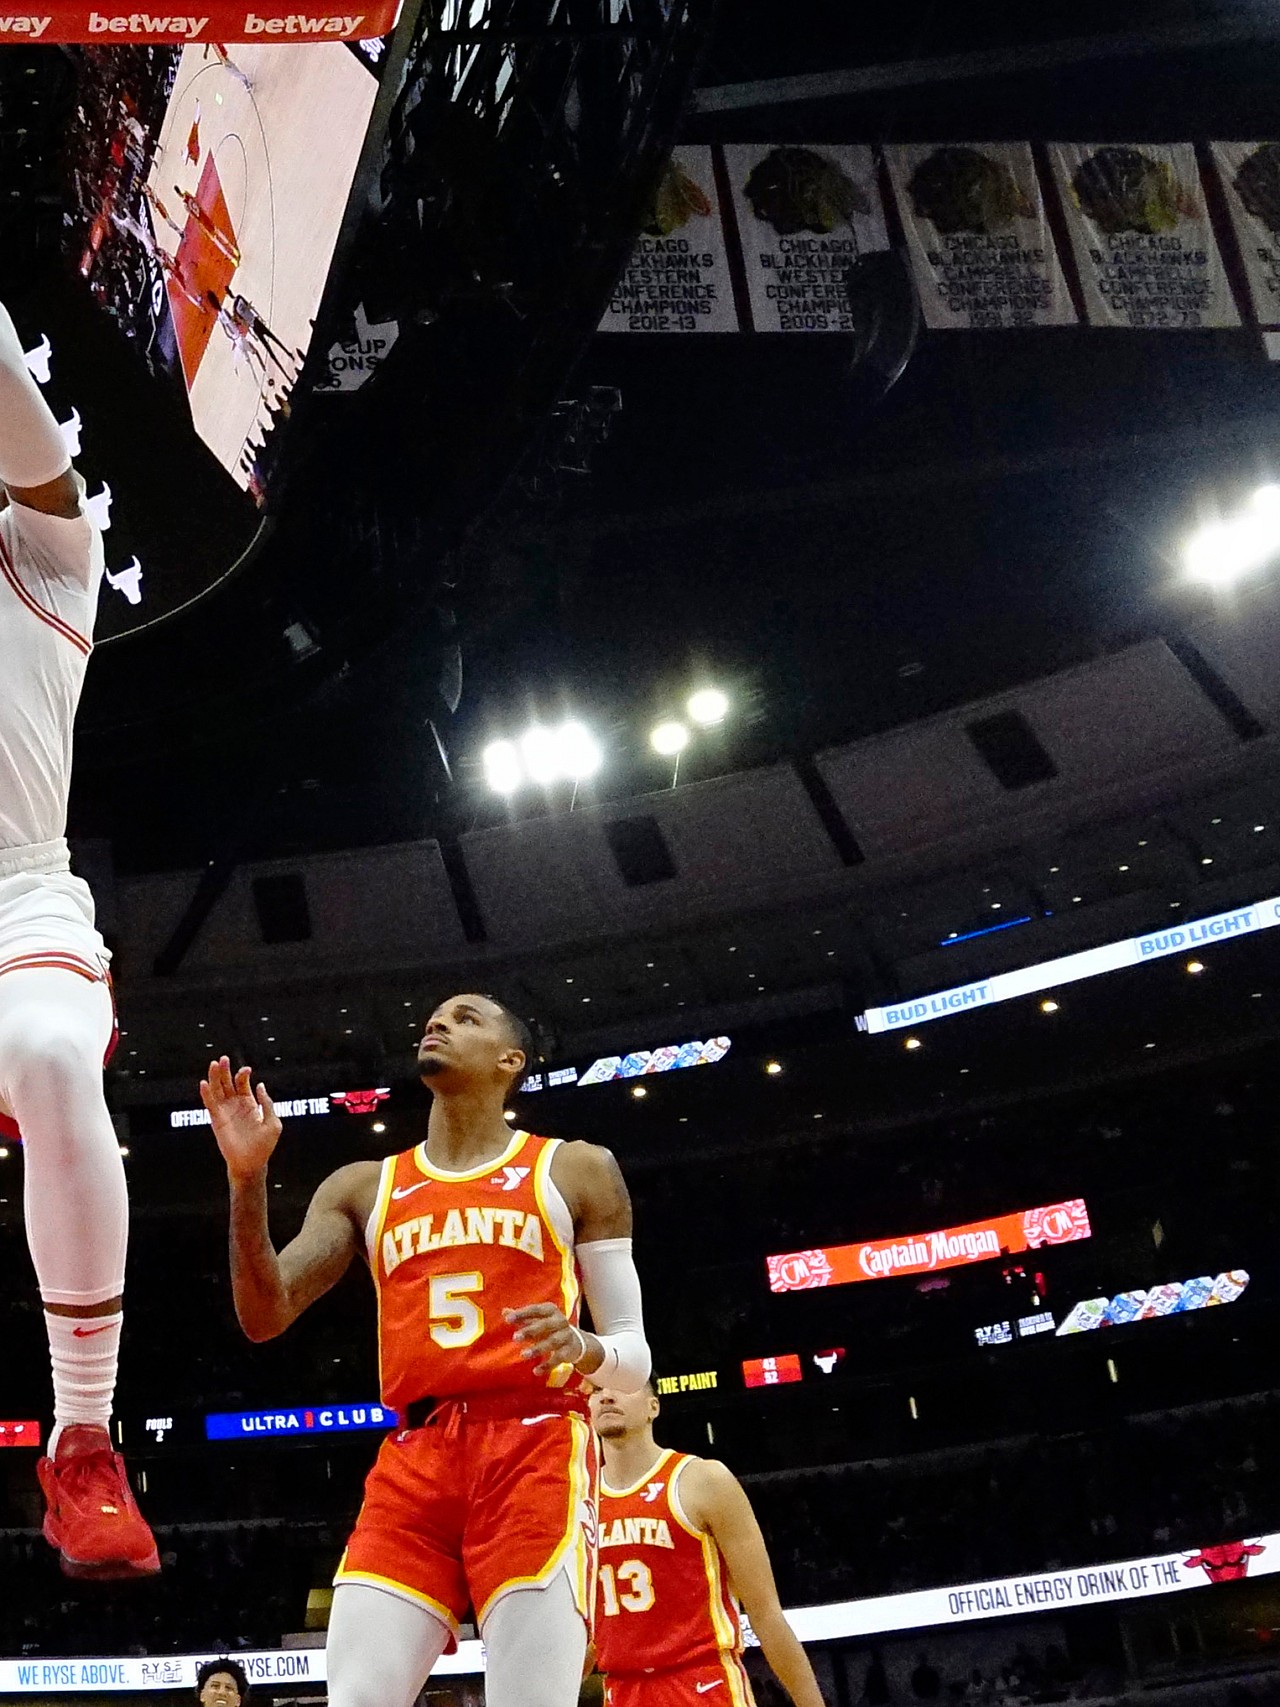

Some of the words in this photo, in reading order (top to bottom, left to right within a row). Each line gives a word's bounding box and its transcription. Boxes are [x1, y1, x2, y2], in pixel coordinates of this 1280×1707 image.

[89, 11, 208, 36] betway
[244, 12, 364, 36] betway
[779, 239, 856, 253] CHICAGO
[610, 301, 711, 315] CHAMPIONS
[629, 315, 696, 330] 2012-13
[1140, 931, 1185, 957] BUD
[1190, 912, 1252, 943] LIGHT
[886, 1002, 928, 1025] BUD
[931, 985, 988, 1014] LIGHT
[294, 1100, 307, 1116] OF
[308, 1098, 329, 1114] THE
[382, 1207, 544, 1277] ATLANTA
[859, 1236, 928, 1276] Captain
[926, 1228, 999, 1269] Morgan
[429, 1271, 484, 1349] 5
[680, 1371, 718, 1392] PAINT
[146, 1418, 173, 1431] FOULS
[241, 1414, 299, 1431] ULTRA
[320, 1408, 384, 1426] CLUB
[156, 1430, 164, 1442] 2
[599, 1560, 656, 1616] 13
[949, 1587, 1013, 1615] OFFICIAL
[1016, 1577, 1073, 1610] ENERGY
[1077, 1566, 1128, 1597] DRINK
[1130, 1563, 1152, 1590] OF
[1155, 1559, 1181, 1585] THE
[18, 1666, 39, 1685] WE
[43, 1665, 78, 1685] RYSE
[80, 1664, 130, 1685] ABOVE.
